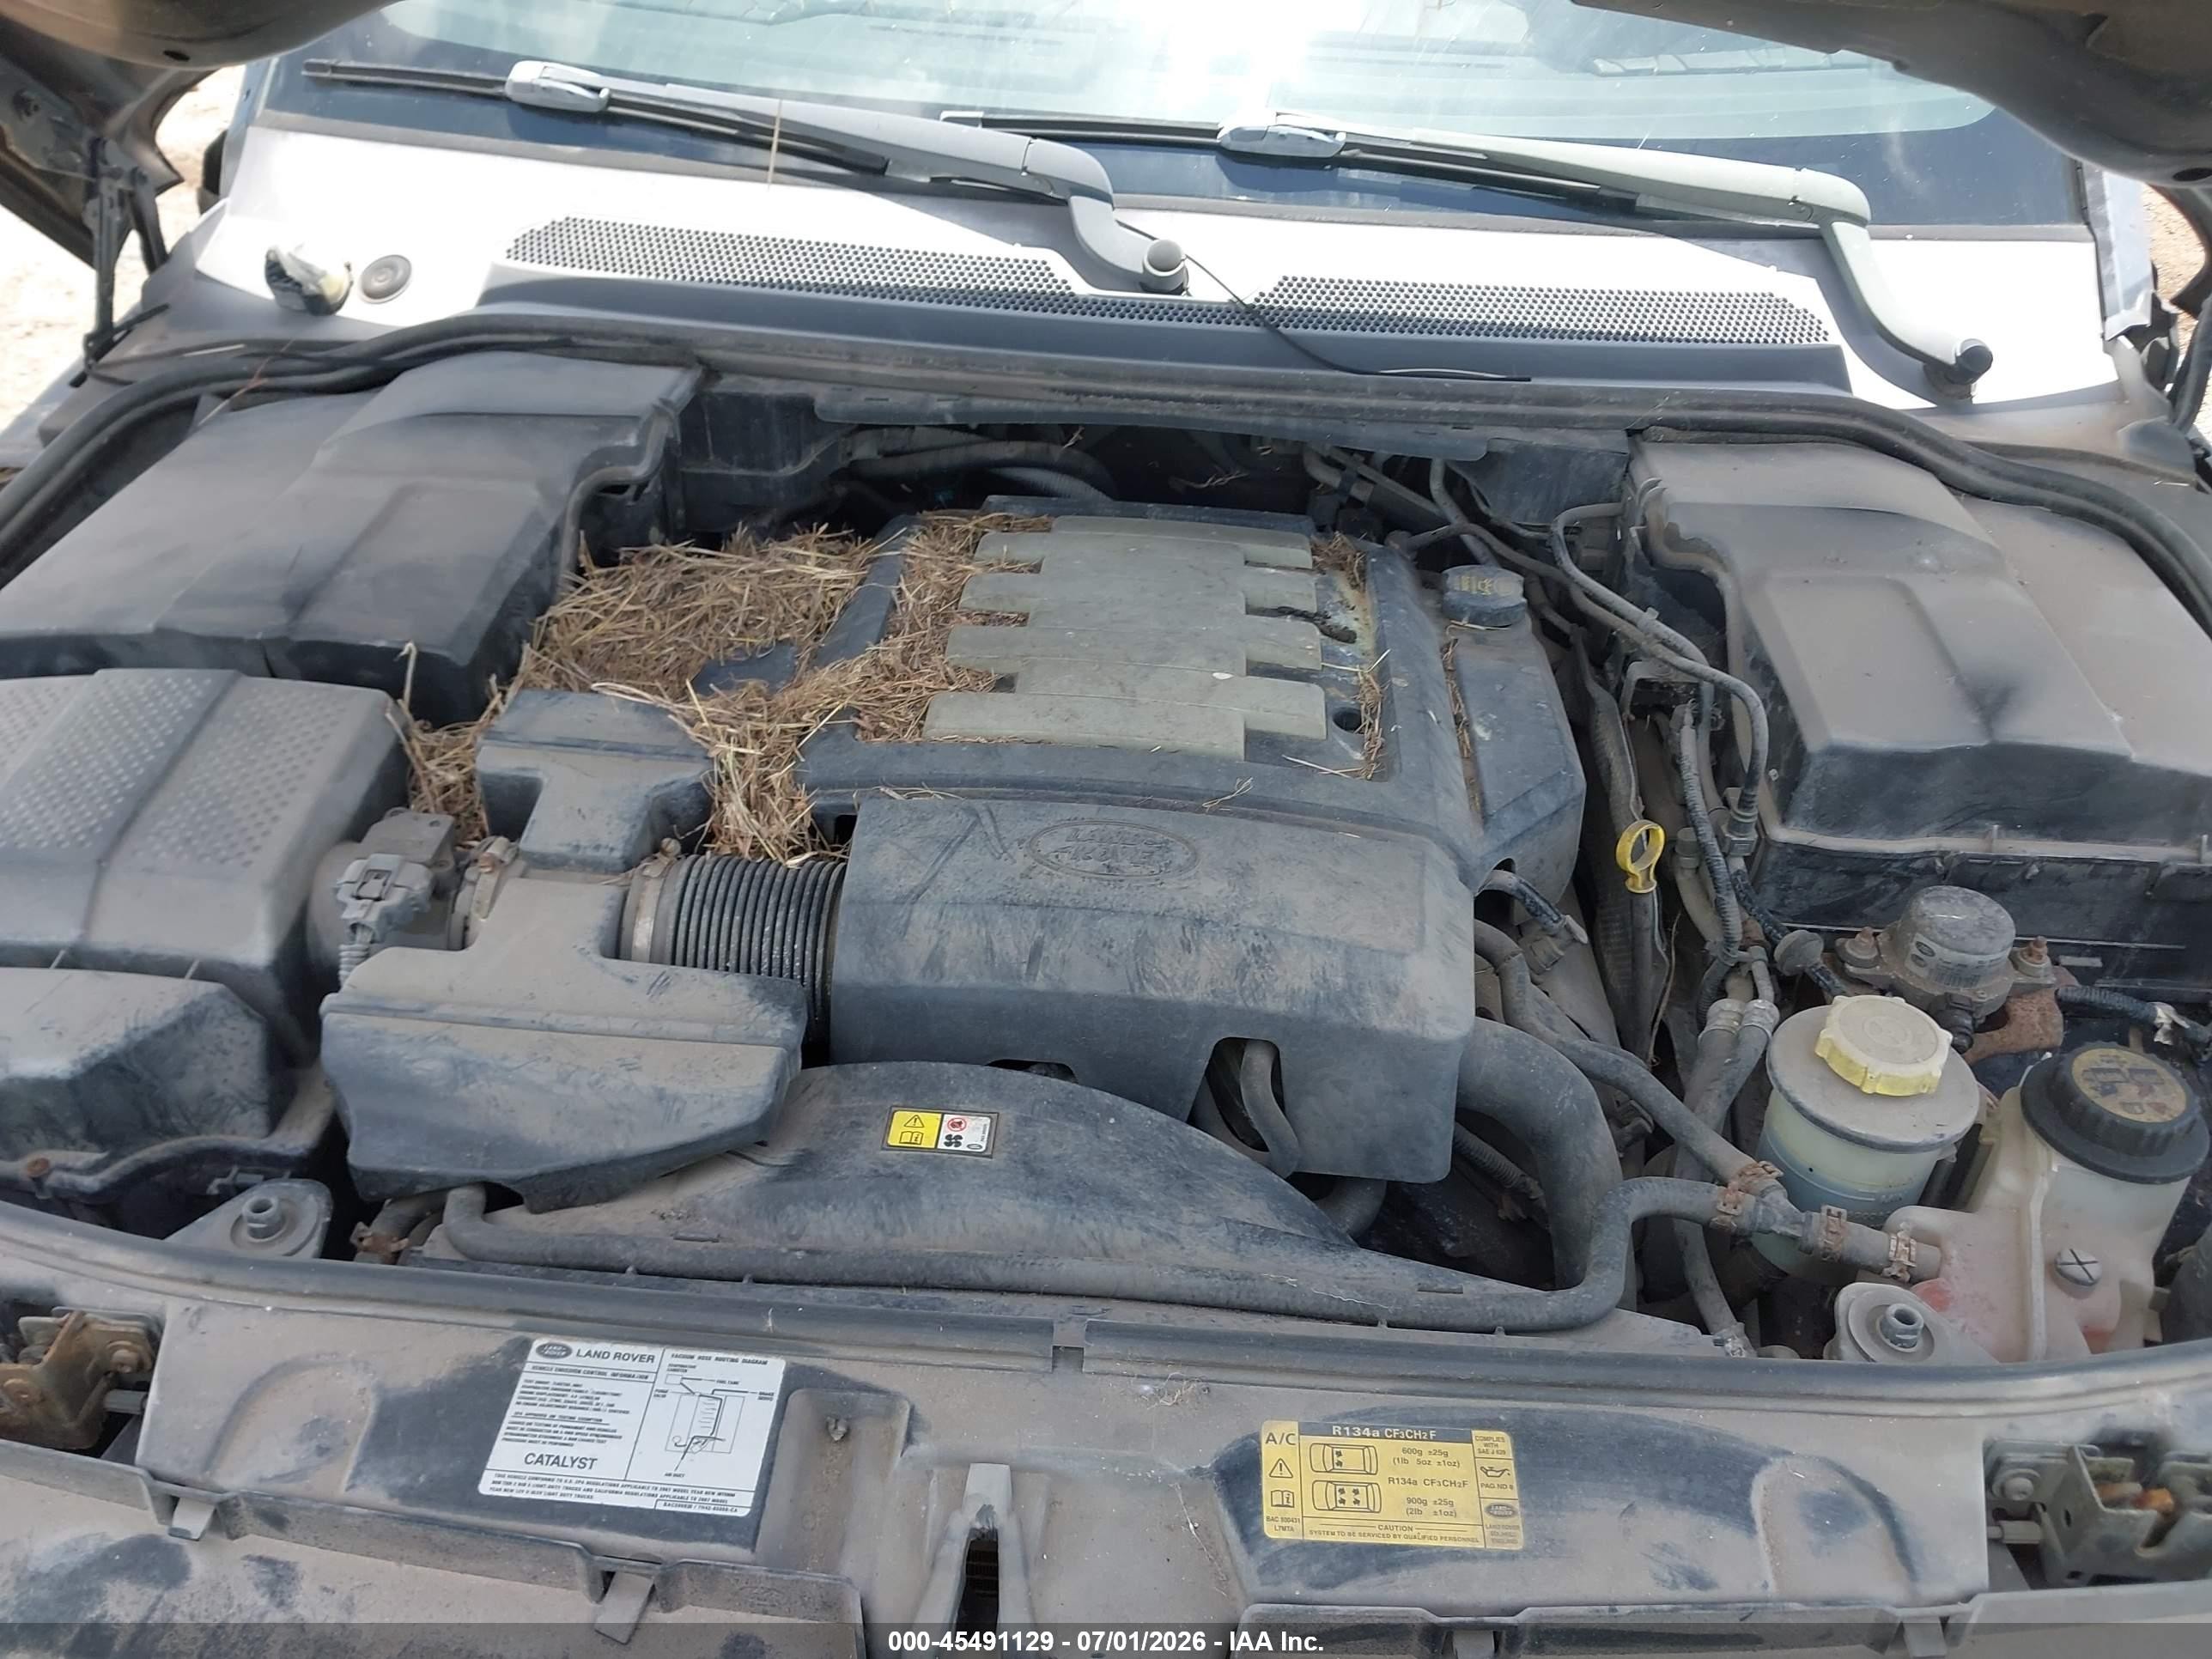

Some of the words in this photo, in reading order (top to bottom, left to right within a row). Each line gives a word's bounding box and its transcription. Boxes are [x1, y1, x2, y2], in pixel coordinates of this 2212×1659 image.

[576, 1349, 611, 1360] LAND
[613, 1352, 655, 1363] ROVER
[1333, 1425, 1380, 1437] R134a
[1266, 1432, 1297, 1445] A/C
[1401, 1448, 1422, 1456] 600g
[525, 1453, 598, 1470] CATALYST
[1437, 1460, 1460, 1468] ±1oz)
[1388, 1477, 1417, 1486] R134a
[1407, 1498, 1427, 1506] 900g
[1433, 1498, 1455, 1507] ±25g
[1407, 1508, 1423, 1516] (2lb
[1433, 1509, 1457, 1518] ±1oz)
